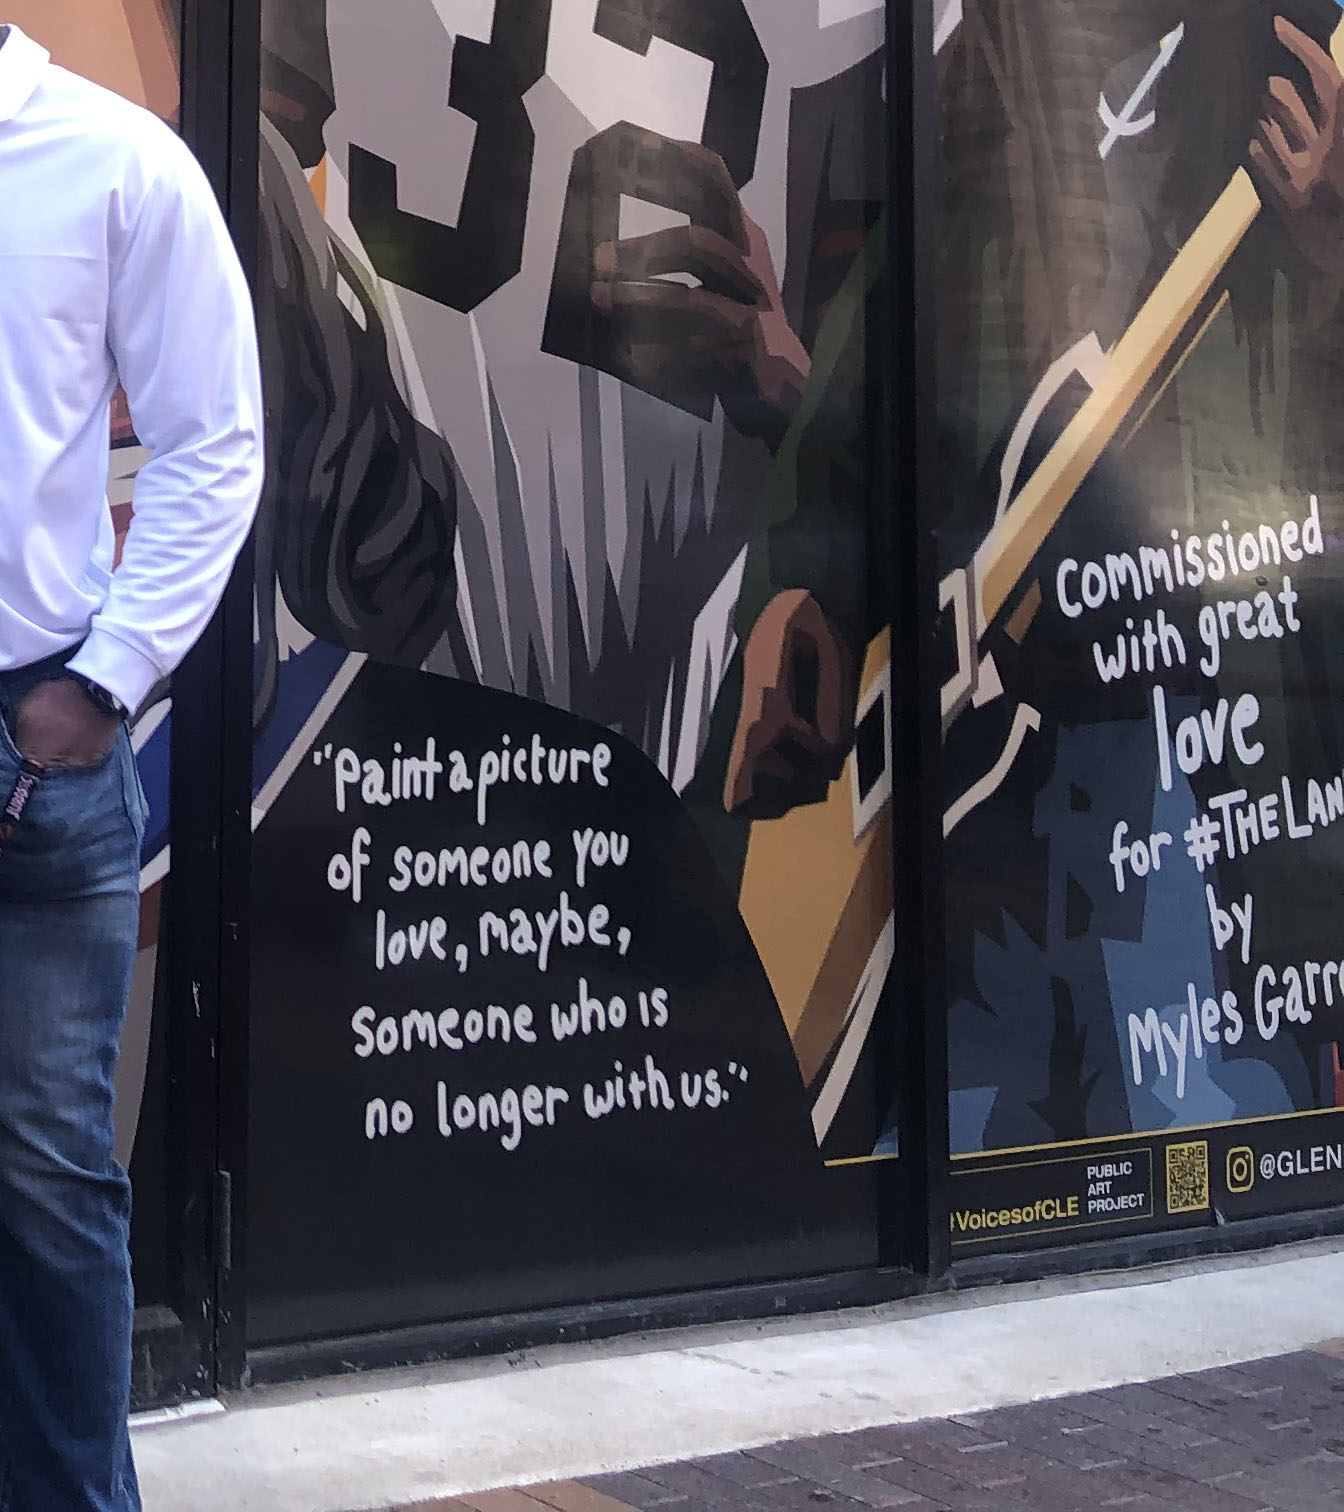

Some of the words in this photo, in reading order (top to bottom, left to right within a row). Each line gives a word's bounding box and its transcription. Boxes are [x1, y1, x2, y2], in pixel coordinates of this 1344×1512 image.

[1093, 609, 1187, 684] with
[1199, 580, 1302, 679] great
[1153, 685, 1265, 792] love
[450, 745, 473, 792] a
[478, 733, 612, 825] picture
[327, 827, 371, 902] of
[389, 838, 552, 892] someone
[573, 826, 629, 887] you
[1110, 820, 1173, 894] for
[1184, 768, 1344, 873] #THELAN
[376, 909, 468, 972] love,
[480, 892, 631, 971] maybe,
[1205, 883, 1253, 965] by
[551, 978, 626, 1041] who
[638, 986, 669, 1029] is
[1127, 982, 1244, 1099] Myles
[365, 1099, 414, 1140] no
[437, 1080, 569, 1151] longer
[584, 1054, 674, 1119] with
[1087, 1161, 1133, 1180] PUBLIC
[1087, 1181, 1112, 1197] ART
[1259, 1143, 1344, 1180] @GLEN
[950, 1195, 1080, 1232] VoicesofCLE
[1087, 1192, 1145, 1214] PROJECT
